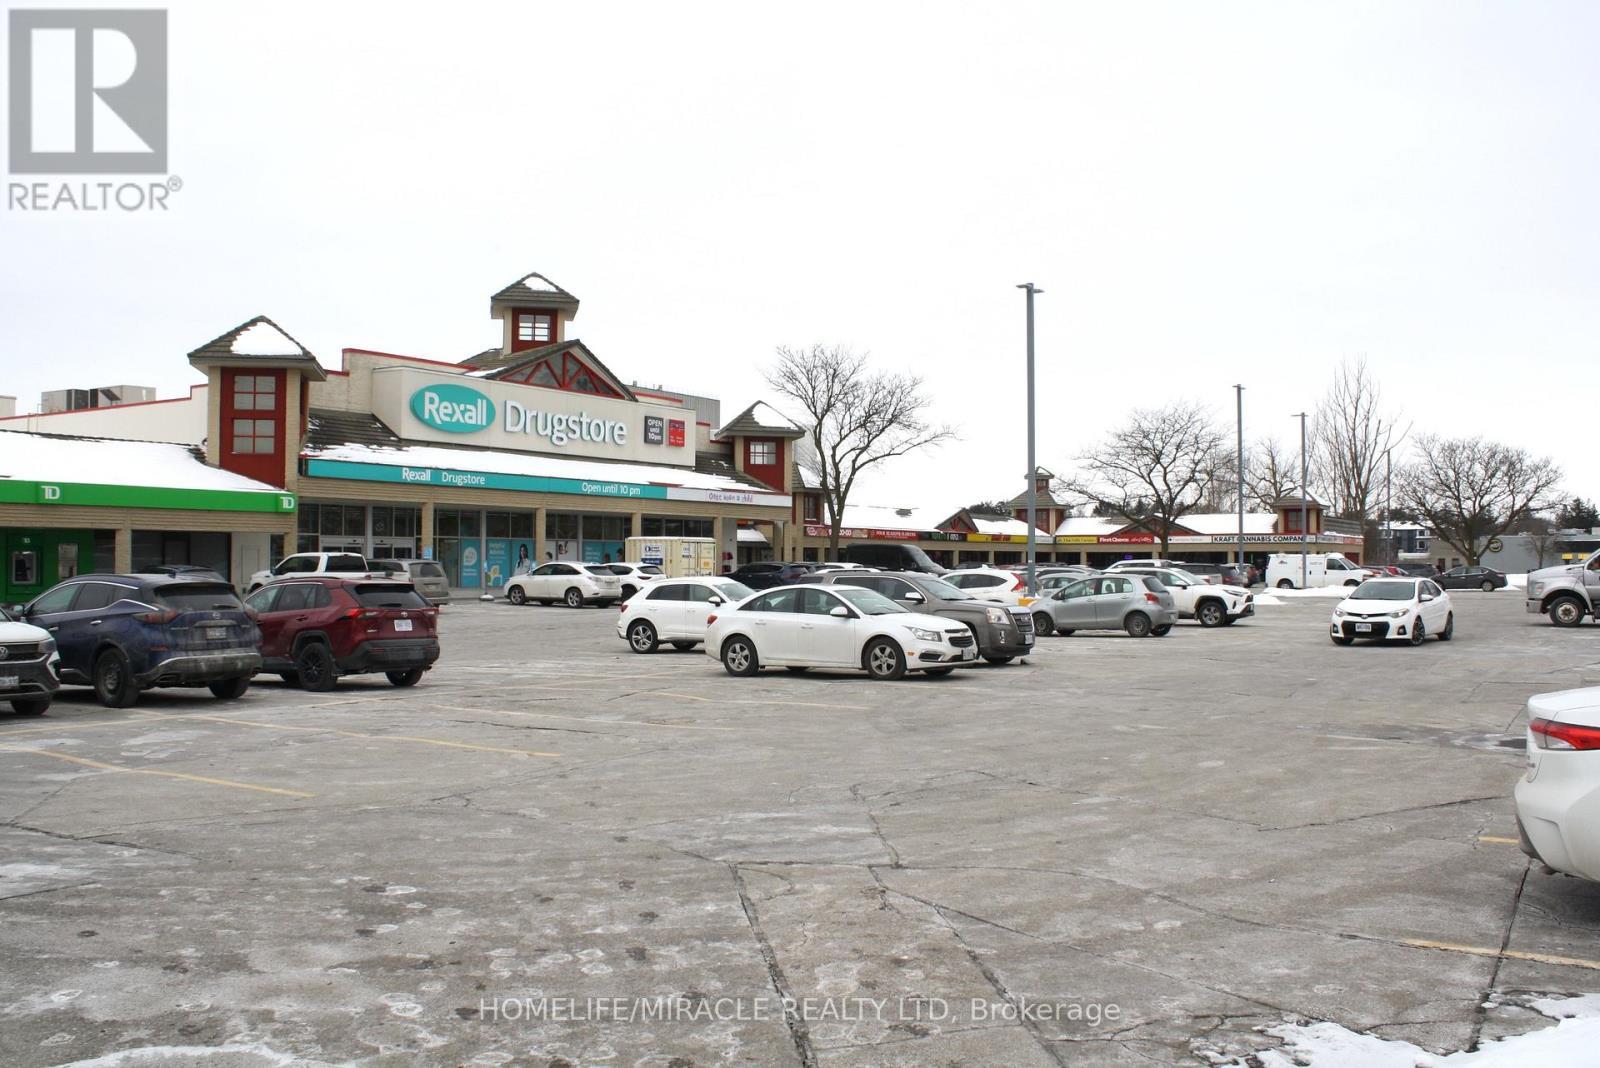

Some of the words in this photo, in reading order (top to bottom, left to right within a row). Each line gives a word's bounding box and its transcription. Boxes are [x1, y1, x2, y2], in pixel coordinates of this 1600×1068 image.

[423, 390, 488, 426] Rexall
[502, 399, 629, 447] Drugstore
[647, 418, 663, 428] OPEN
[401, 467, 431, 482] Rexall
[441, 471, 486, 486] Drugstore
[41, 485, 61, 501] TD
[581, 482, 602, 495] Open
[602, 483, 618, 495] until
[619, 485, 628, 495] 10
[629, 487, 641, 497] pm
[279, 496, 295, 509] TD
